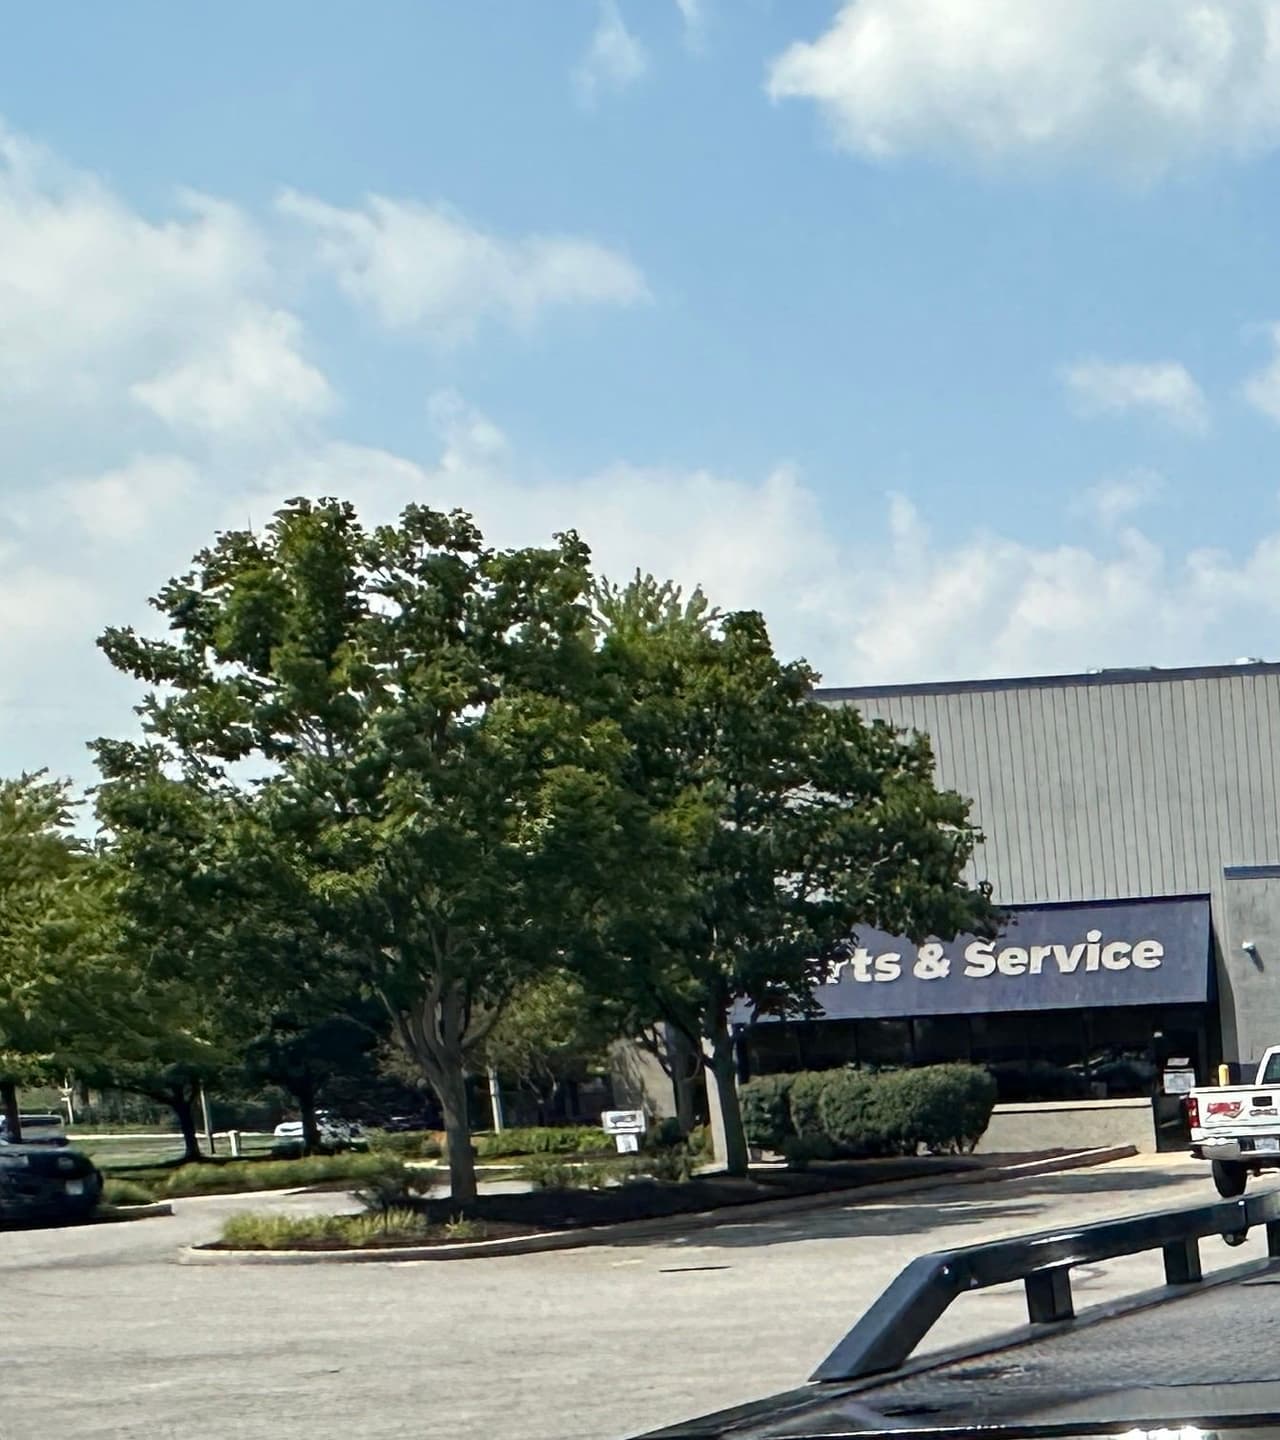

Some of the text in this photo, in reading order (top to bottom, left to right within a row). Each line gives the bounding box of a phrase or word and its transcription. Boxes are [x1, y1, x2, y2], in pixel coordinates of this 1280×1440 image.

[805, 929, 1165, 984] rts & Service
